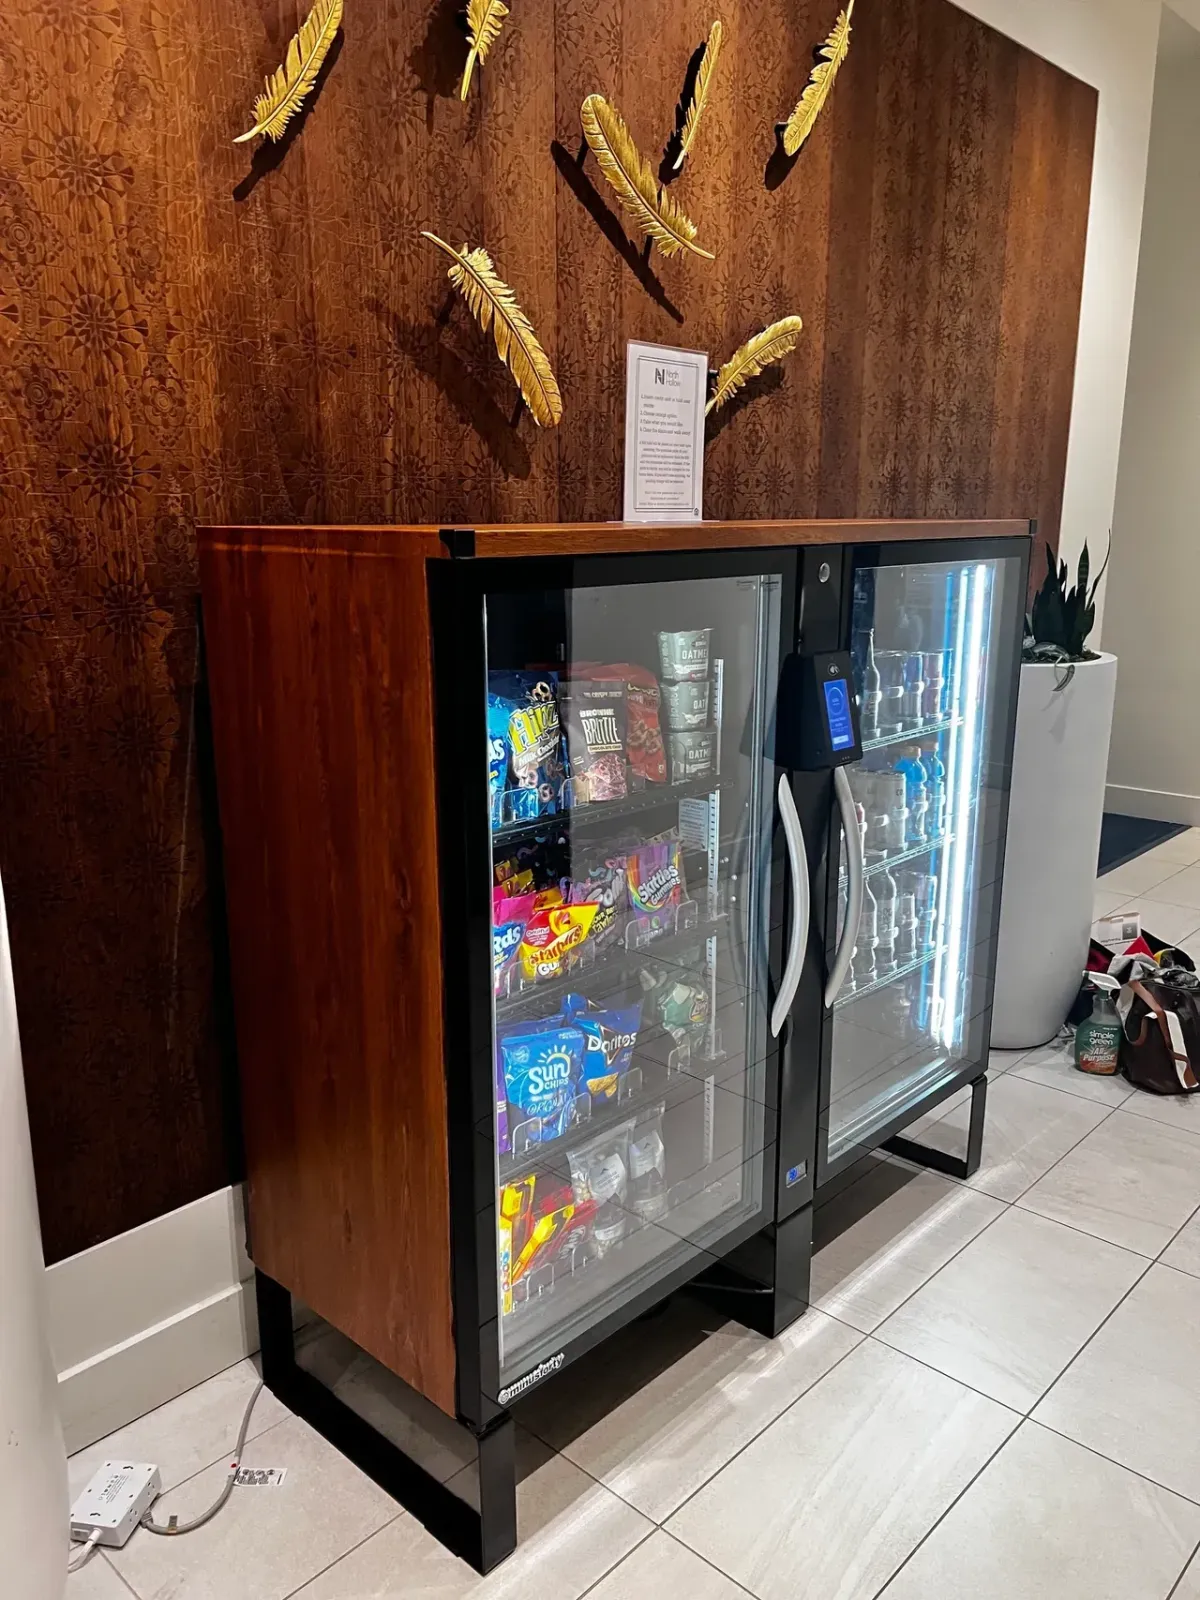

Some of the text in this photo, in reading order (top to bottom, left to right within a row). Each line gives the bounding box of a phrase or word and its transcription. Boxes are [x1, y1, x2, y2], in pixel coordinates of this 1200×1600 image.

[637, 865, 679, 903] Skittles
[1089, 1030, 1115, 1039] simple
[586, 1032, 637, 1053] Doritos
[1089, 1038, 1113, 1046] green
[544, 1077, 569, 1090] CHIPS
